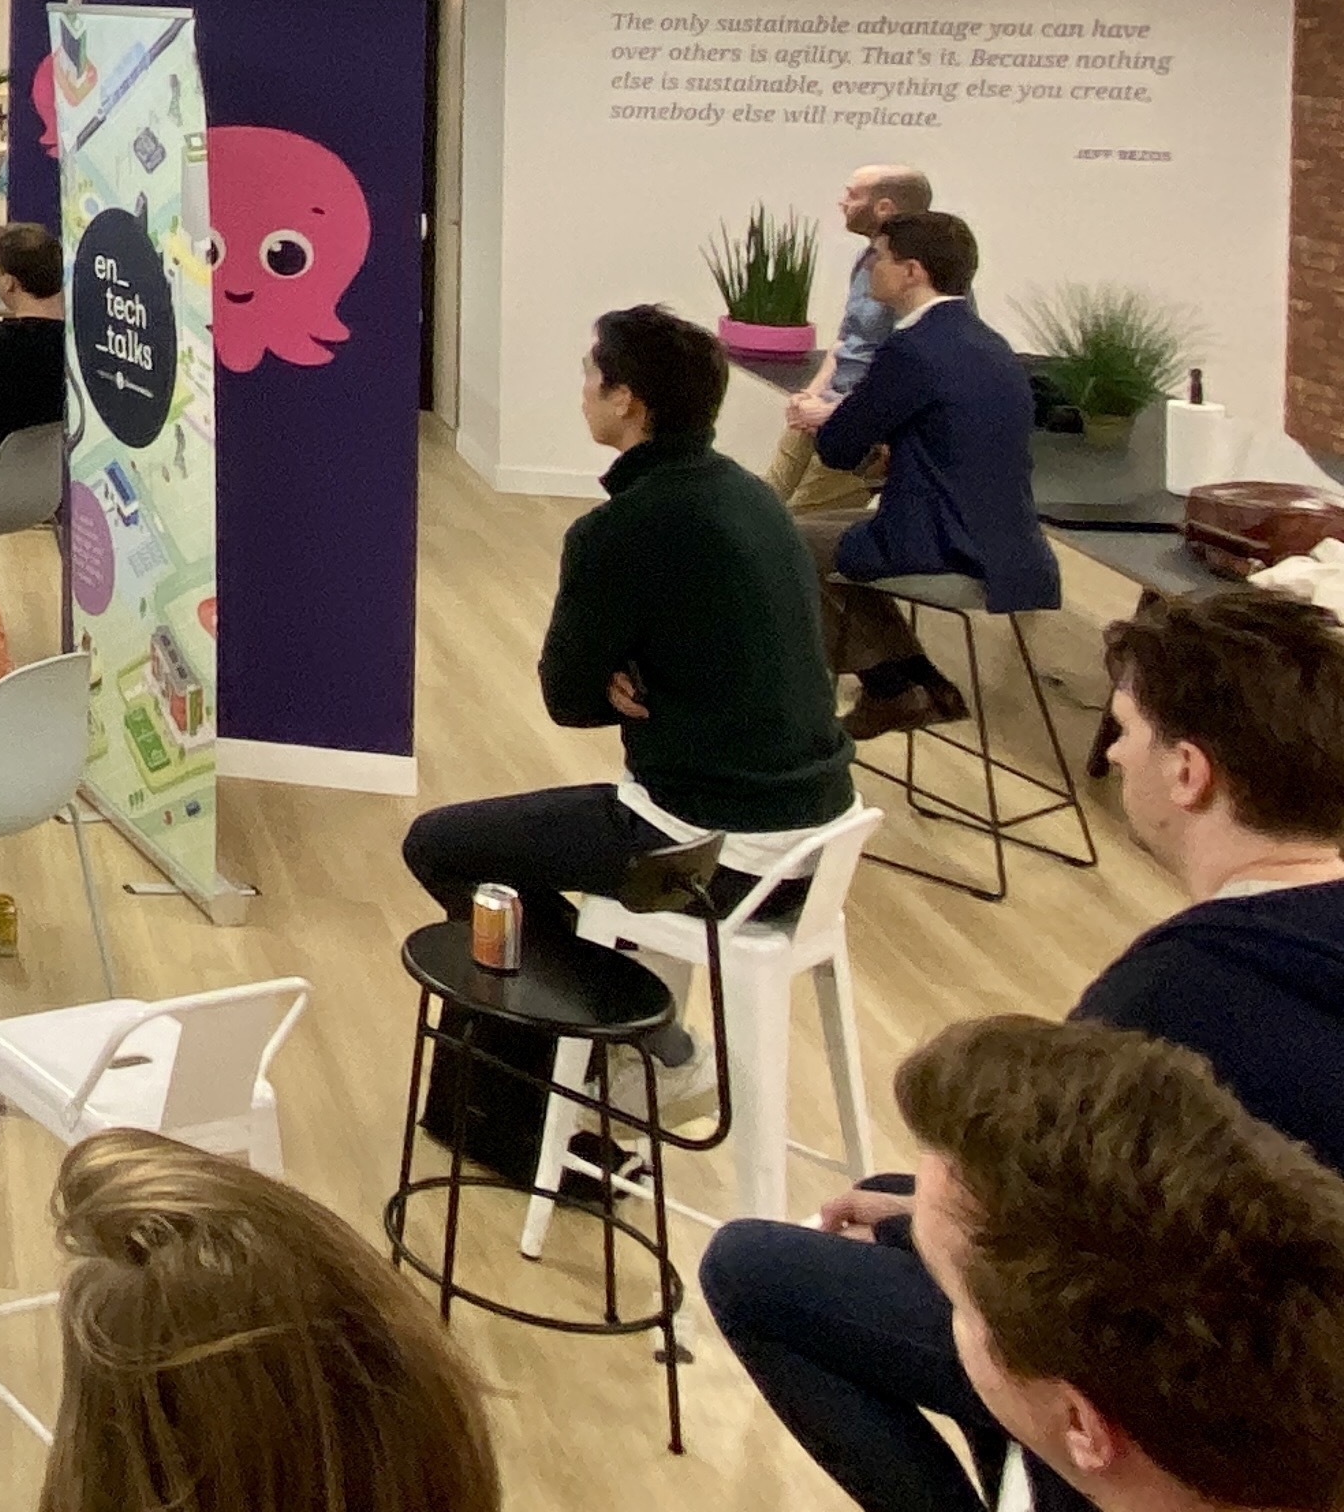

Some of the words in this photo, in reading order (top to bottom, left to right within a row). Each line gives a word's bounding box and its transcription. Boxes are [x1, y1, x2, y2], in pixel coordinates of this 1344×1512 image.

[612, 13, 654, 31] The
[660, 13, 709, 36] only
[717, 15, 850, 34] sustainable
[857, 14, 983, 41] advantage
[988, 21, 1032, 41] you
[1041, 22, 1084, 38] can
[1092, 19, 1151, 39] have
[612, 45, 661, 61] over
[669, 43, 742, 62] others
[750, 44, 767, 63] is
[862, 46, 931, 66] That's
[970, 49, 1069, 69] Because
[1075, 50, 1175, 75] nothing
[611, 72, 653, 90] else
[661, 71, 679, 90] is
[685, 74, 823, 96] sustainable,
[832, 77, 960, 102] everything
[966, 79, 1012, 99] else
[1014, 83, 1063, 103] you
[611, 102, 725, 126] somebody
[732, 105, 776, 123] else
[784, 104, 827, 125] will
[834, 106, 942, 129] replicate.
[106, 287, 146, 330] tech
